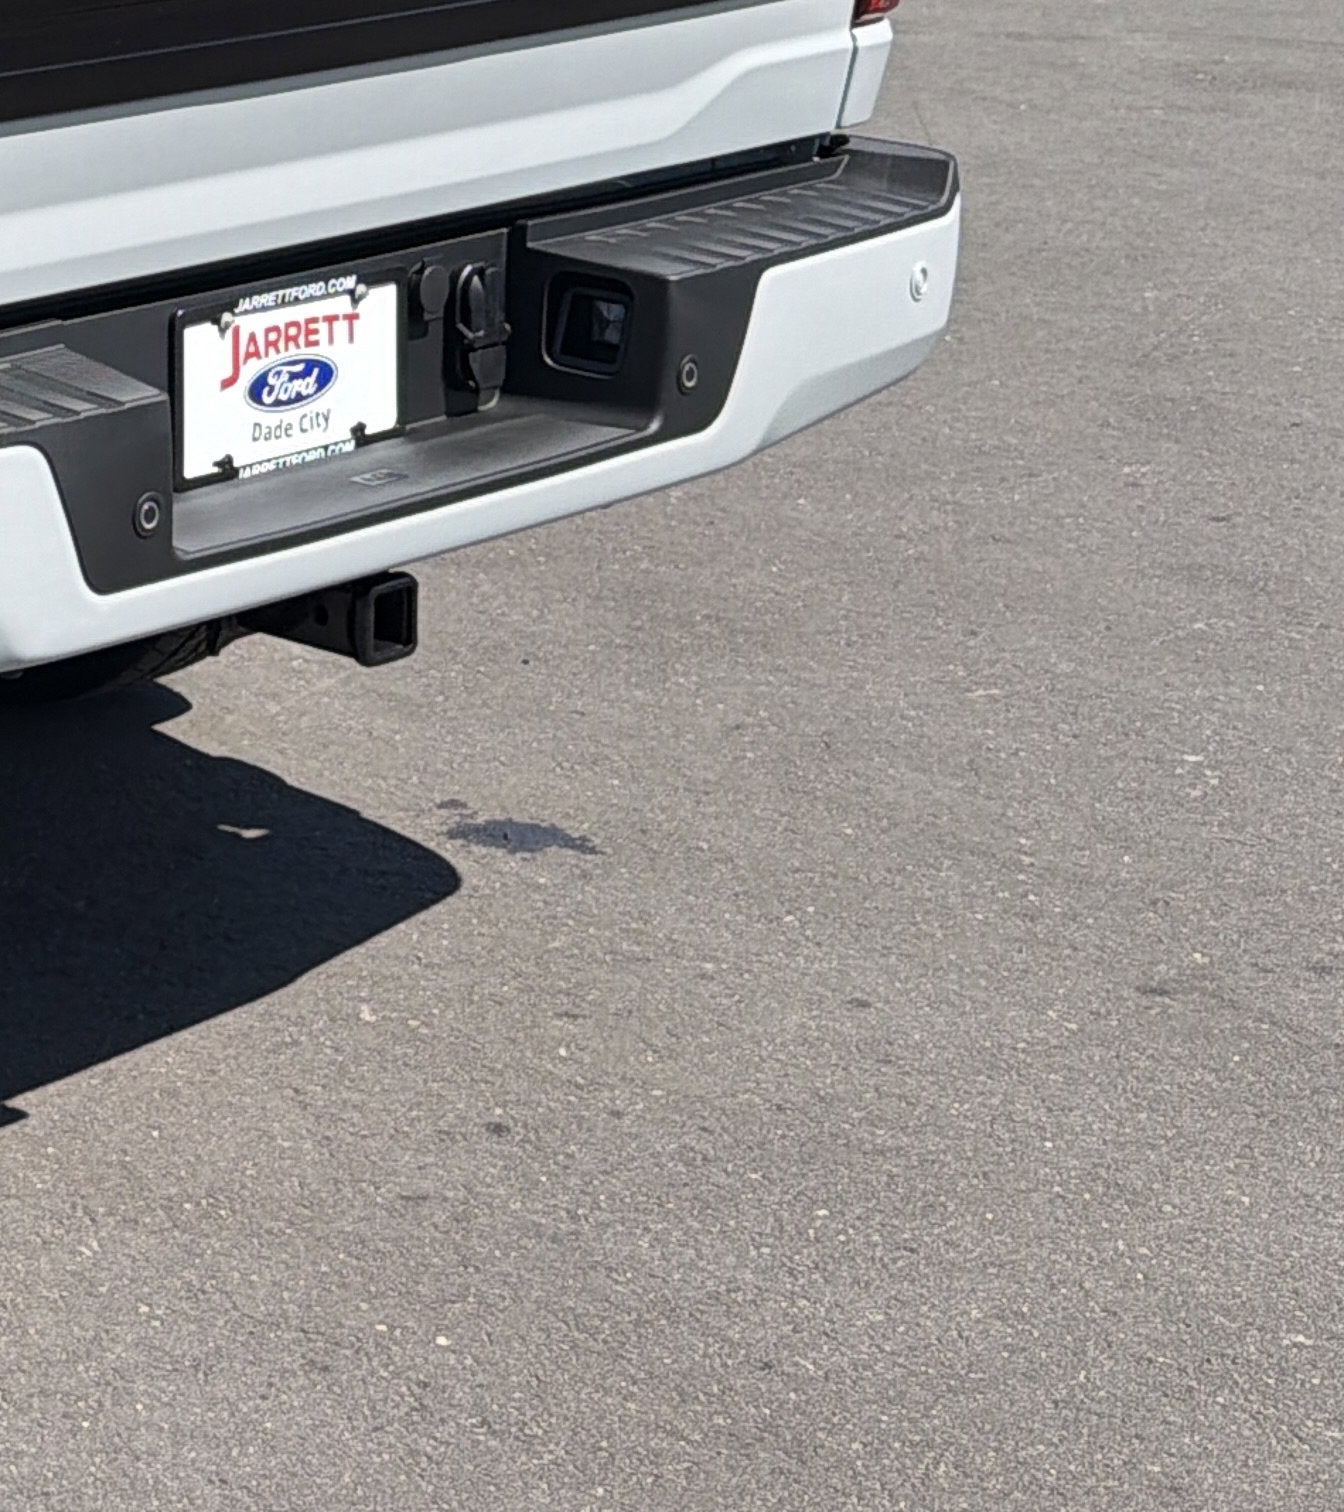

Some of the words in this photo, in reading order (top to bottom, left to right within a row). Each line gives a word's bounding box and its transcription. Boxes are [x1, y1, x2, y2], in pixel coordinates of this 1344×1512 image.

[234, 274, 357, 312] JARRETTFORD.COM
[220, 313, 359, 392] JARRETT
[261, 362, 319, 404] Ford
[252, 419, 293, 442] Dade
[299, 409, 331, 435] City
[238, 440, 355, 480] JARRETTFORDCOM
